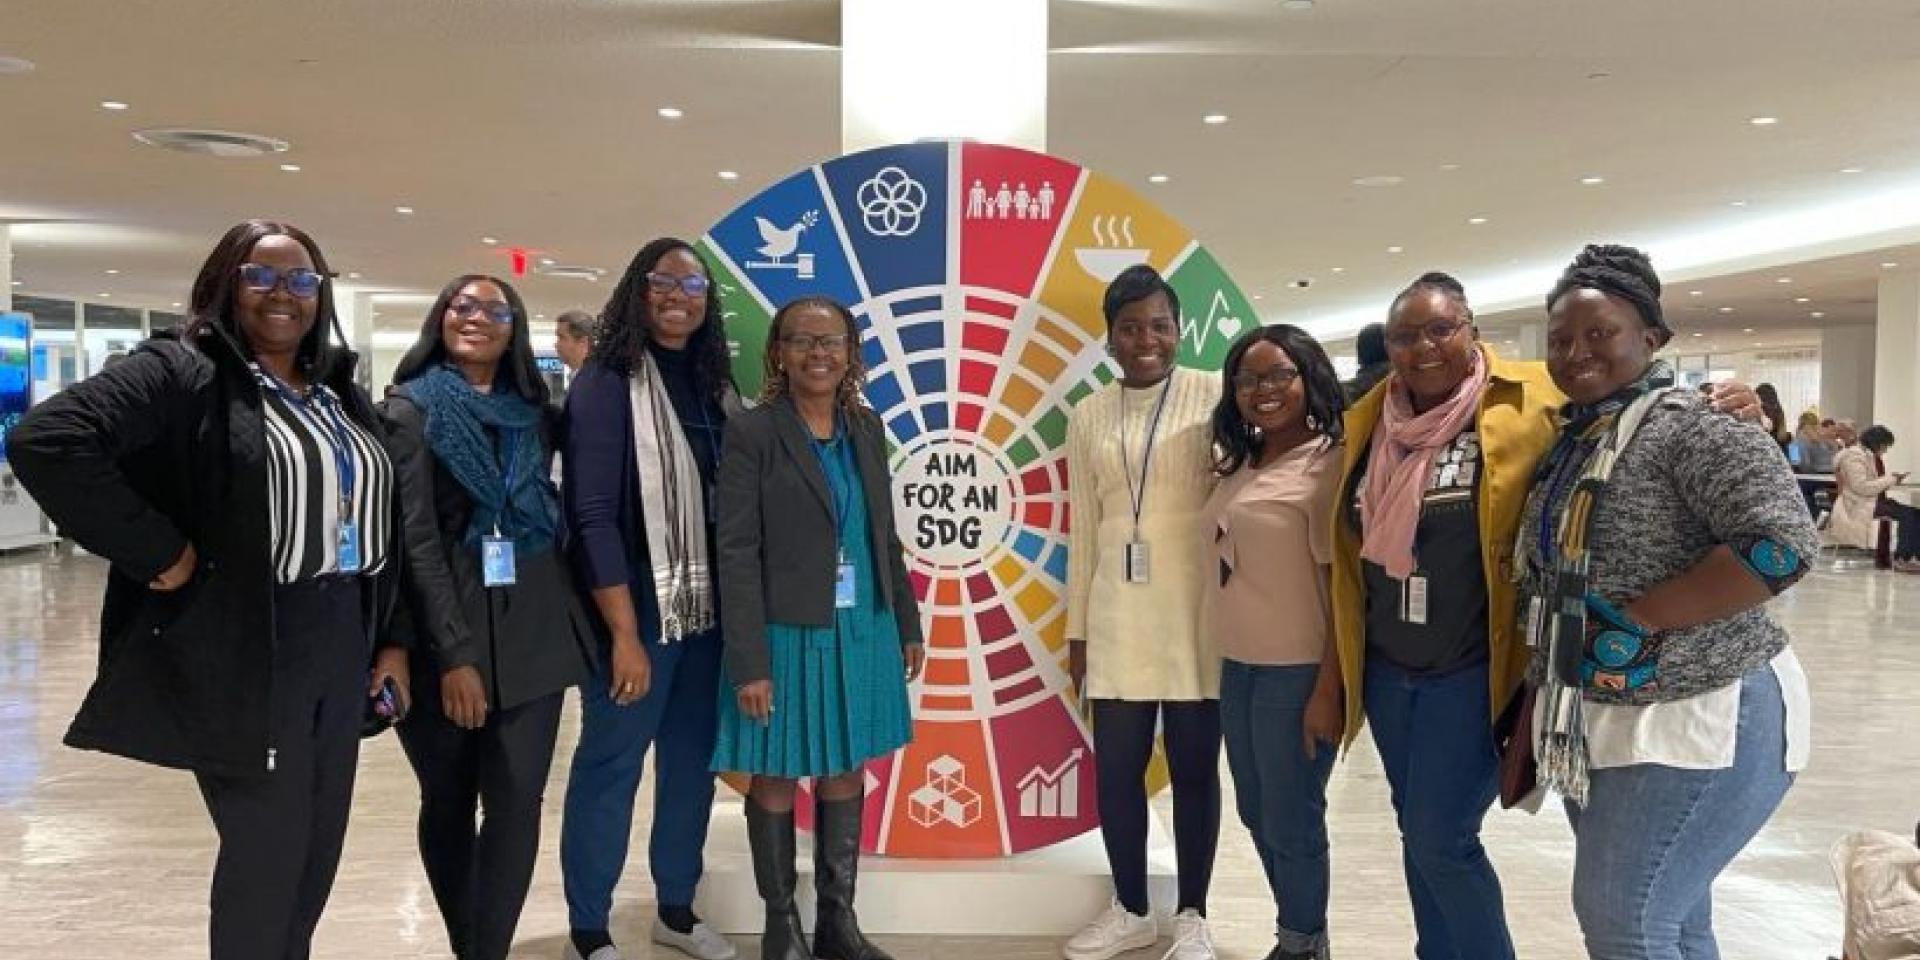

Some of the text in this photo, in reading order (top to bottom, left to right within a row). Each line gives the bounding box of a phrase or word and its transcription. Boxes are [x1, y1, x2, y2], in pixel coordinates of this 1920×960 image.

[925, 453, 977, 477] AIM
[903, 483, 998, 512] FOR AN
[916, 514, 982, 549] SDG
